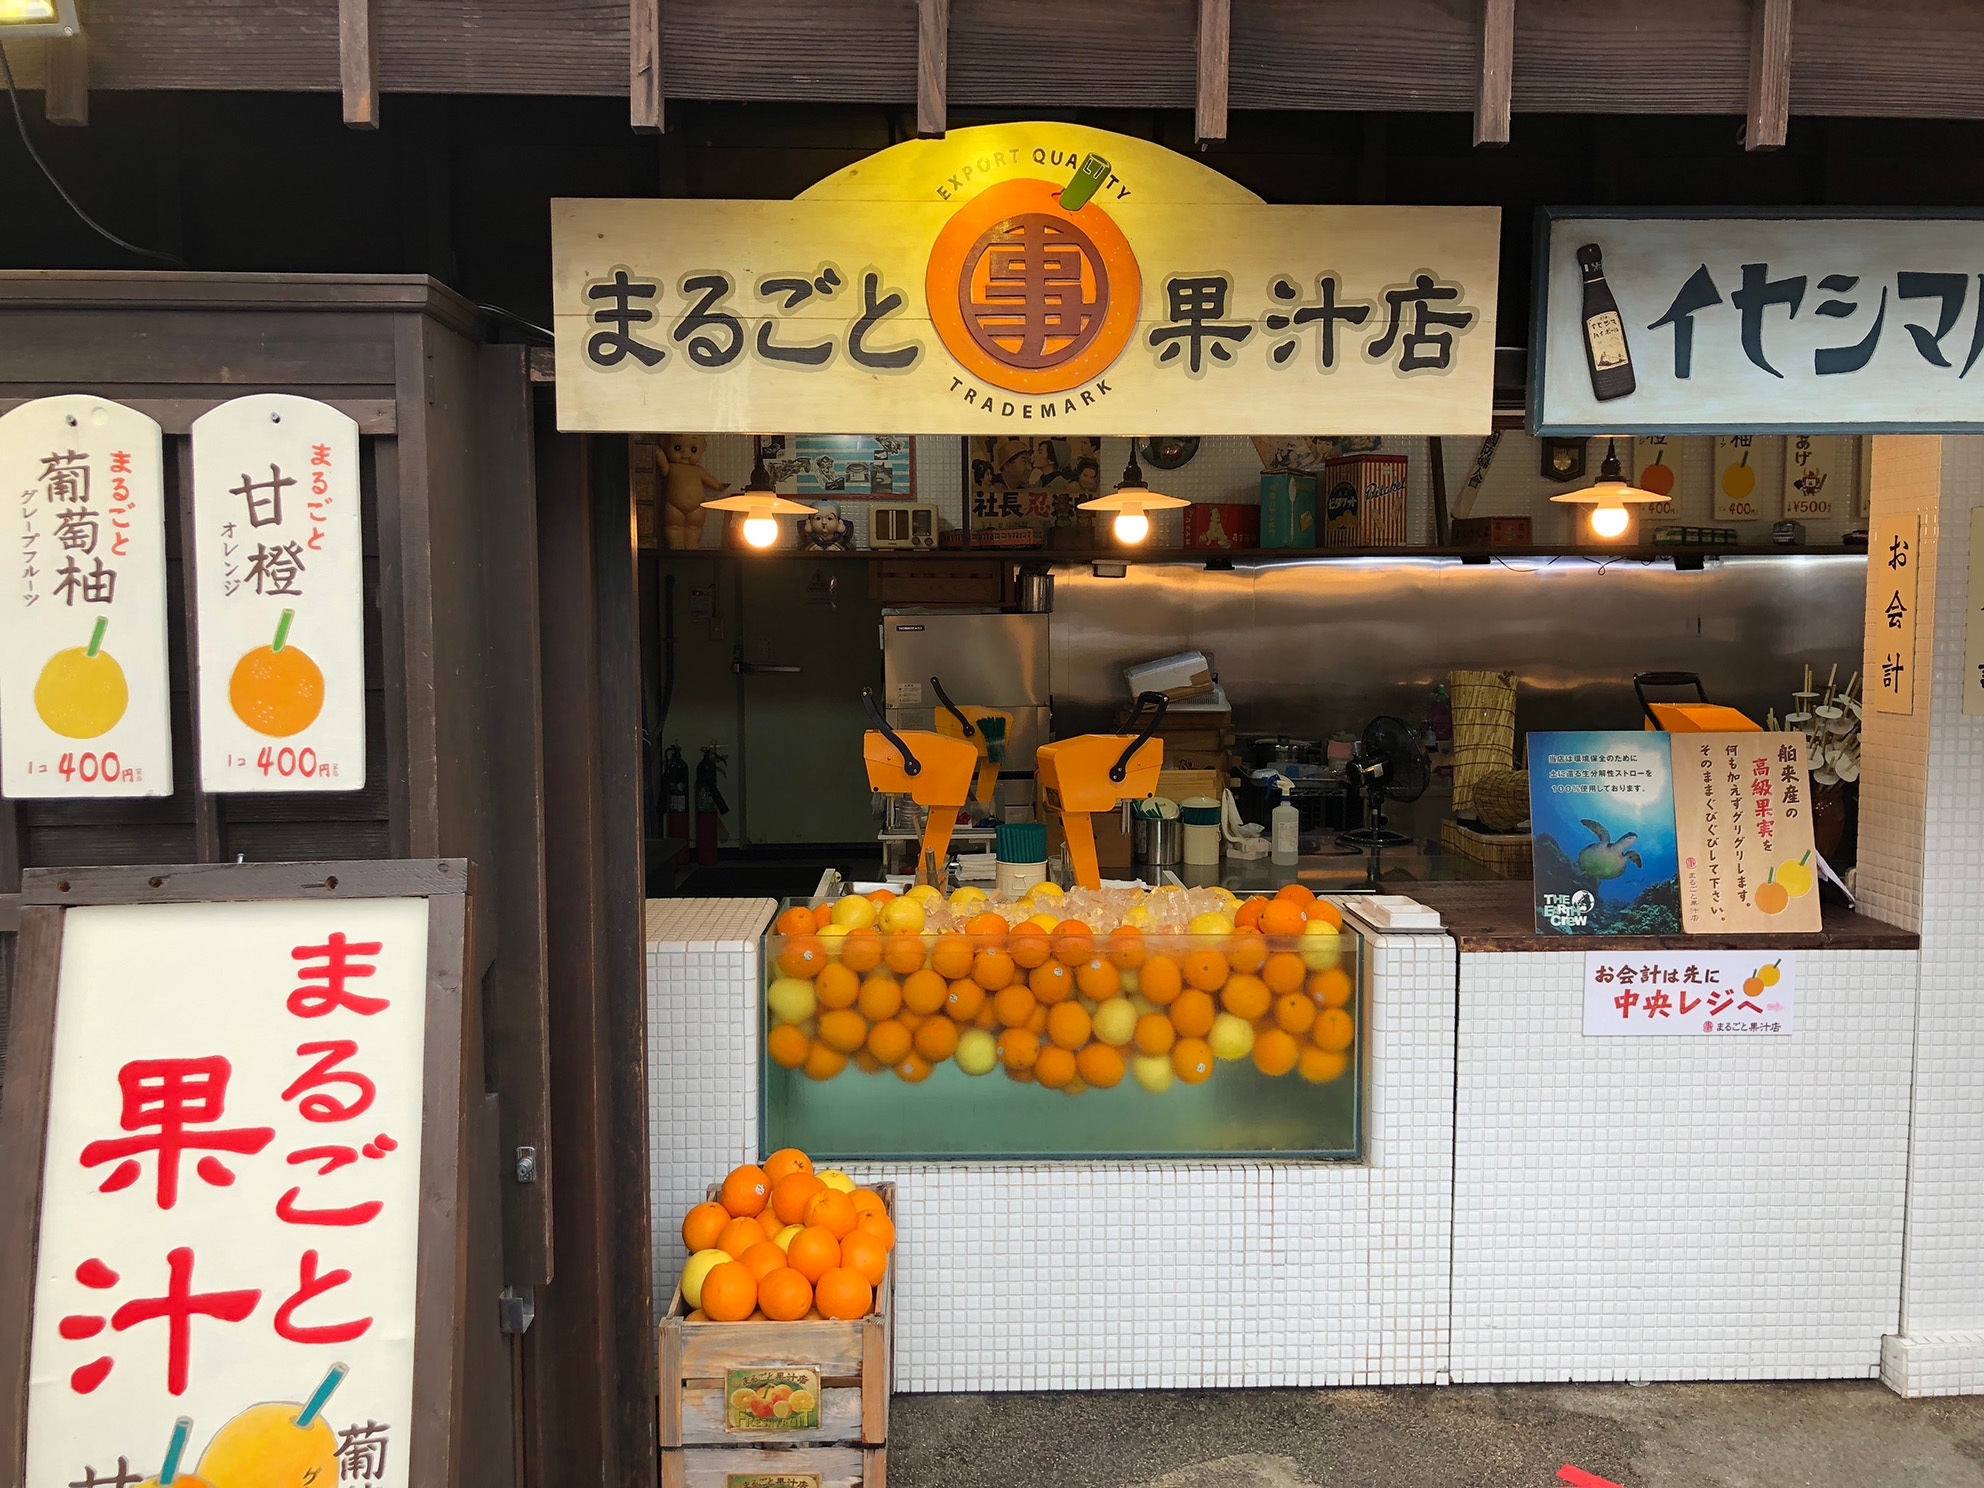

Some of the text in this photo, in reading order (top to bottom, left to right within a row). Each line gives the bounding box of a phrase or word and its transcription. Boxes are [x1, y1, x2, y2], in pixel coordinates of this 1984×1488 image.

[937, 147, 1131, 201] EXPORT QUALITY
[586, 265, 921, 368] まるごと
[1150, 274, 1474, 371] 果汁店
[1647, 262, 1984, 379] イセシマ
[949, 376, 1113, 419] TRADEMARK
[37, 448, 118, 607] 葡萄柚
[108, 450, 136, 556] まるごと
[229, 463, 306, 596] 甘橙
[307, 443, 333, 551] まるごと
[20, 488, 41, 608] グレープフルーツ
[220, 521, 241, 597] オレンジ
[1881, 534, 1909, 694] お会計
[1549, 753, 1638, 763] 当店は環境保全のために
[1549, 769, 1653, 778] 土に還る生分解性ストローを
[1777, 744, 1800, 819] 舶来産の
[1700, 744, 1725, 922] そのままぐびぐびして下さい。
[1725, 744, 1751, 908] 何も加えずグリグリします。
[1751, 757, 1775, 852] 高級果実を
[1543, 894, 1570, 905] THE
[1543, 904, 1581, 917] EARTH
[1688, 872, 1700, 922] まるごと果汁店
[1595, 964, 1720, 985] お会計は先に
[1613, 988, 1764, 1019] 中央レジへ
[1716, 1021, 1782, 1032] まるごと果汁店
[274, 931, 398, 1344] まるごと
[59, 1054, 276, 1396] 果汁
[742, 1371, 809, 1385] まるごと果汁店
[333, 1418, 392, 1488] 葡
